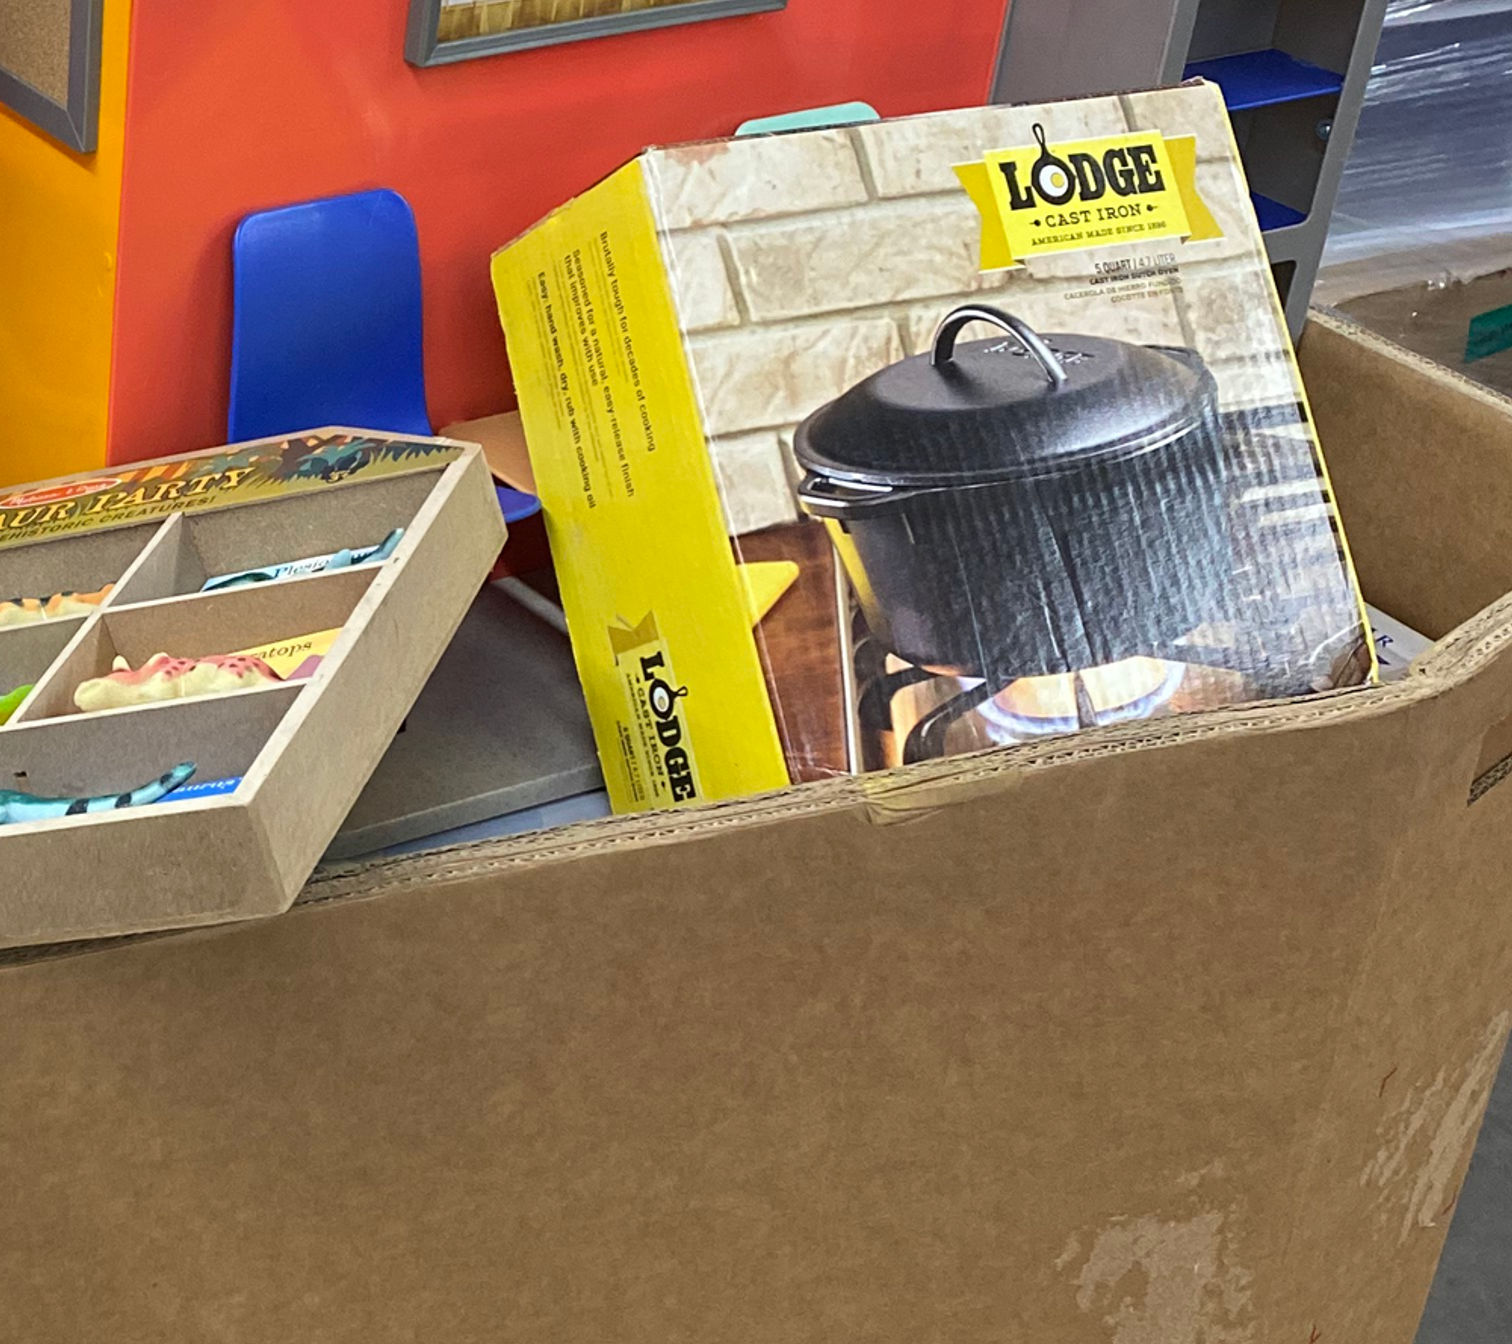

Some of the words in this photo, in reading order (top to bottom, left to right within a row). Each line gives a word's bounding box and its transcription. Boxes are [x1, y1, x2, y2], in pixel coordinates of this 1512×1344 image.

[999, 130, 1166, 211] LODGE
[1031, 230, 1084, 247] AMERICAN
[1086, 227, 1114, 239] MADE
[1045, 209, 1092, 228] CAST
[1098, 203, 1142, 222] IRON
[564, 254, 575, 278] that
[1103, 258, 1131, 273] QUART
[569, 278, 588, 335] improves
[582, 337, 595, 365] with
[600, 231, 616, 278] Brutally
[611, 278, 625, 317] tough
[623, 334, 641, 388] decades
[639, 403, 657, 452] cooking
[544, 304, 557, 335] hand
[569, 418, 581, 445] with
[576, 446, 591, 492] cooking
[573, 249, 592, 307] Seasoned
[621, 463, 635, 498] finish
[588, 367, 598, 387] use
[87, 466, 256, 516] PARTY
[99, 496, 215, 524] CREATURES!
[637, 686, 653, 731] CAST
[649, 734, 665, 778] IRON
[640, 651, 696, 803] LODGE
